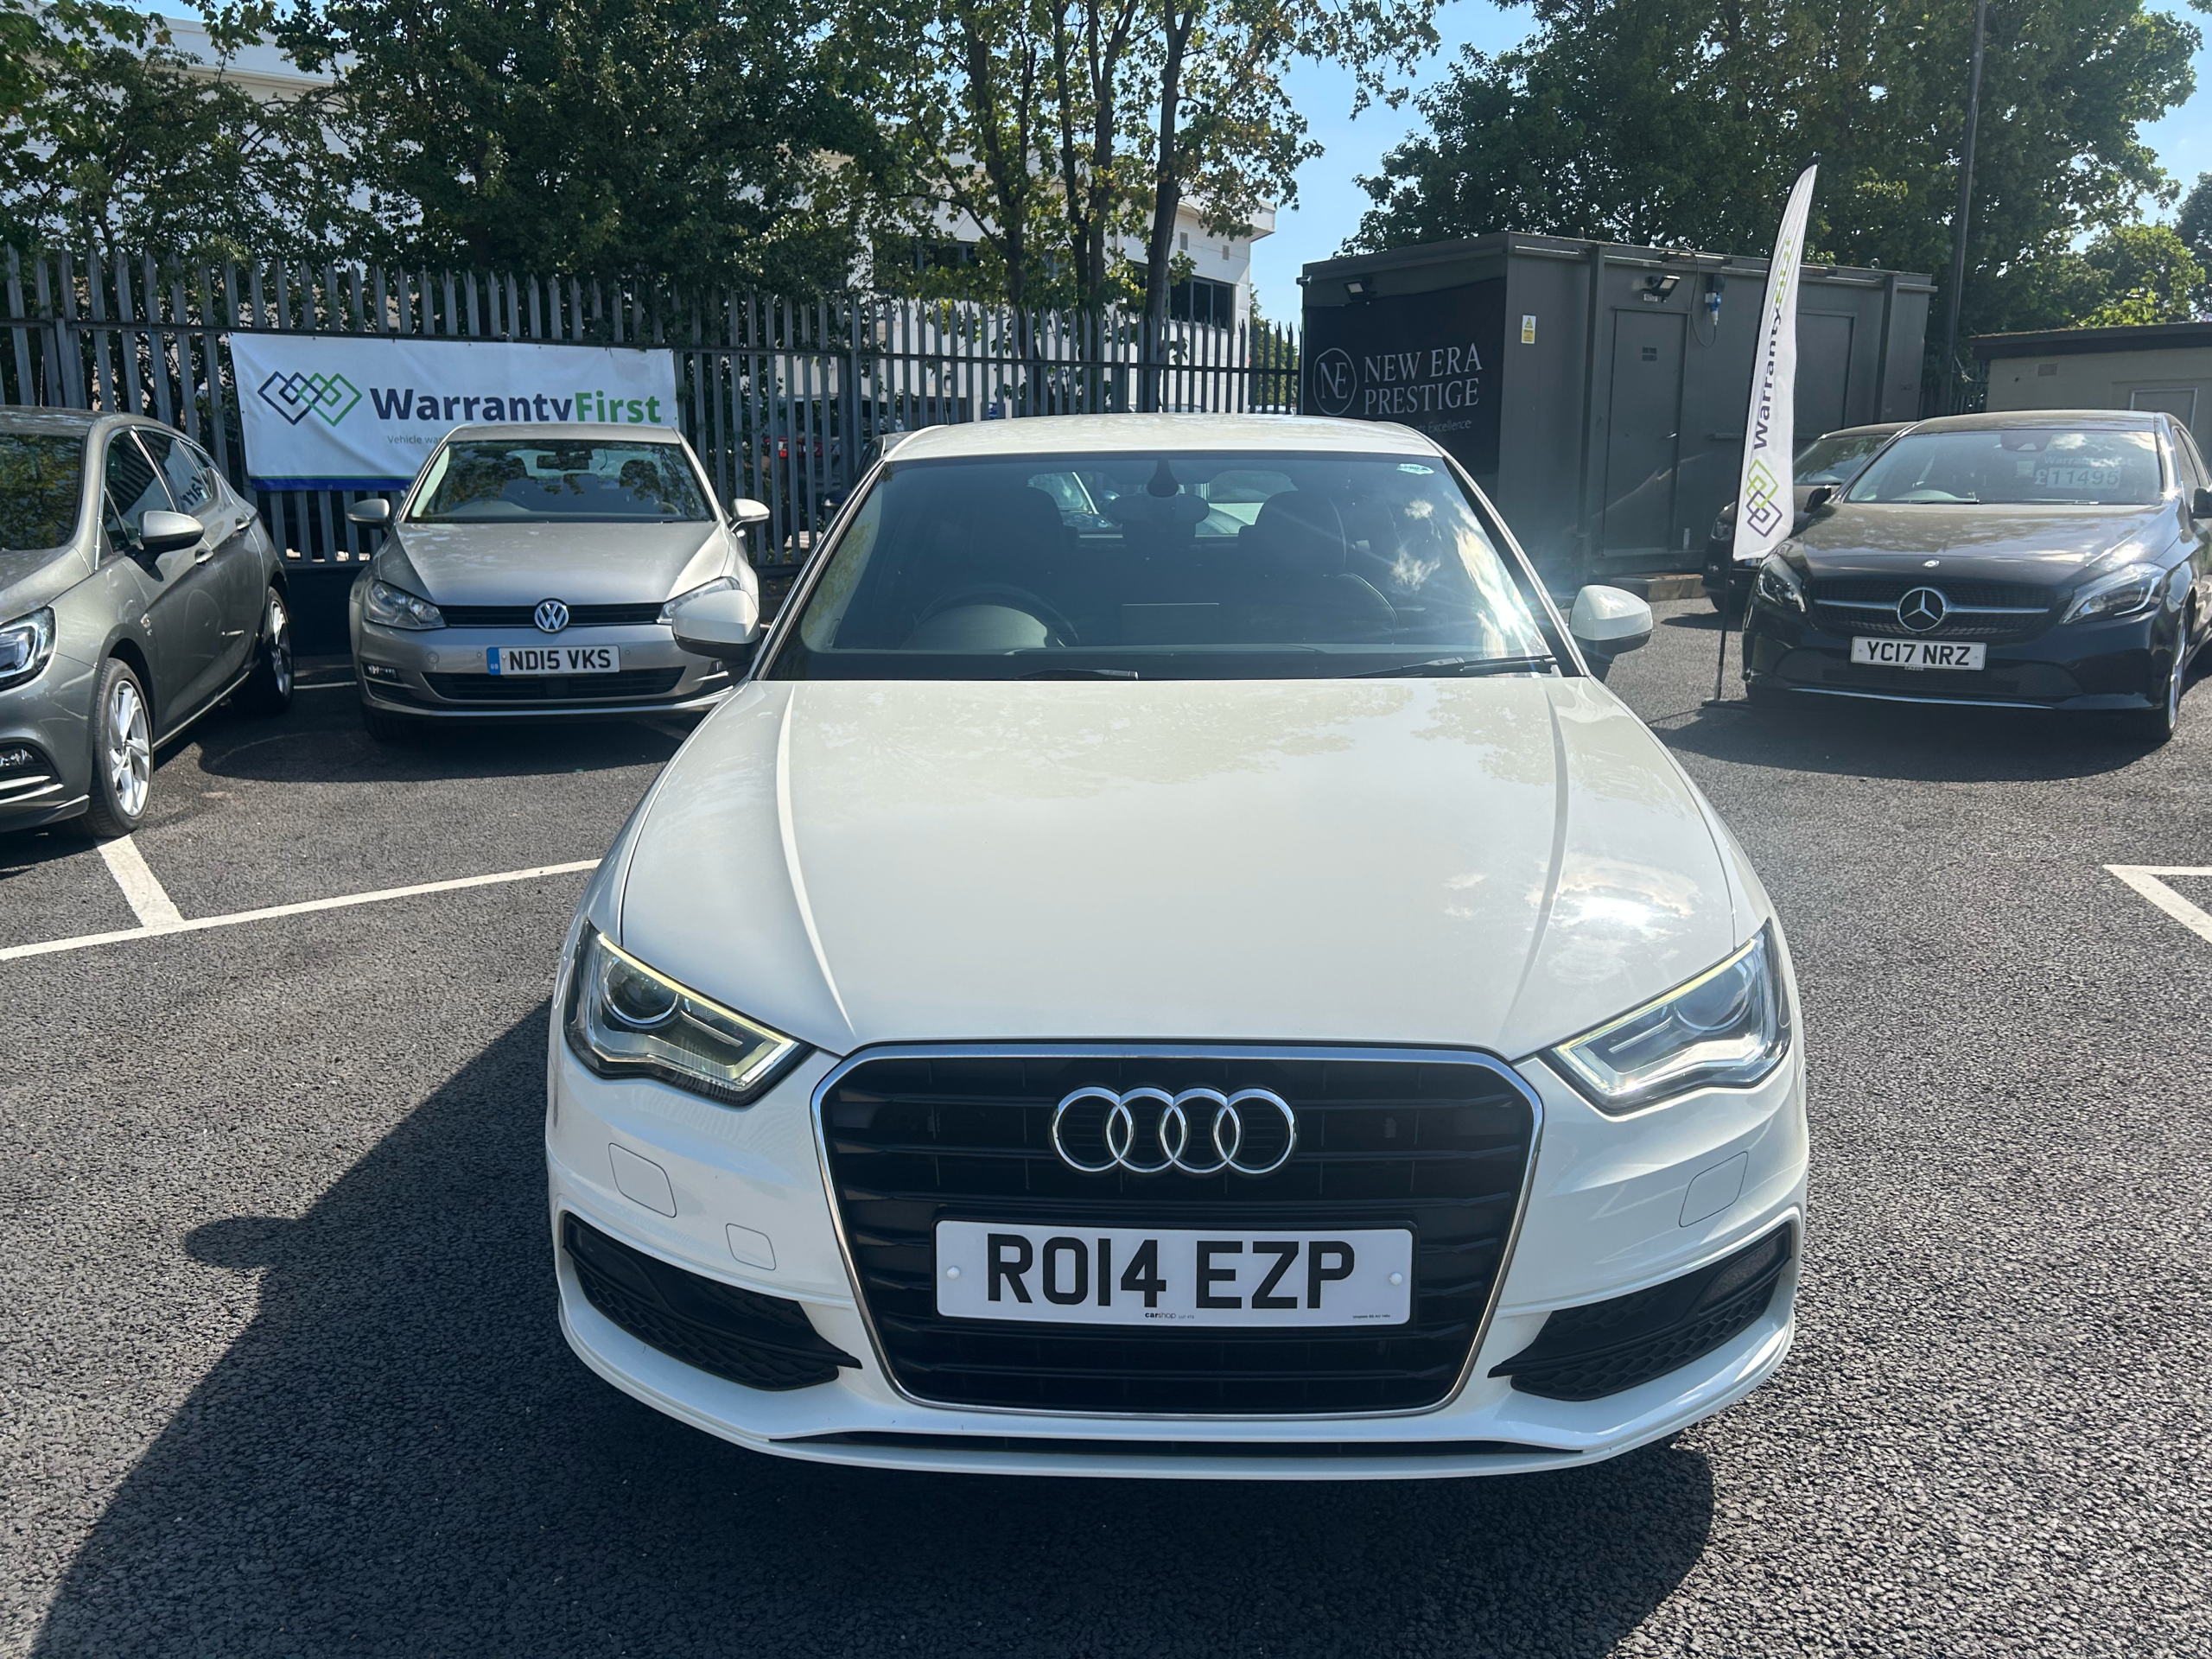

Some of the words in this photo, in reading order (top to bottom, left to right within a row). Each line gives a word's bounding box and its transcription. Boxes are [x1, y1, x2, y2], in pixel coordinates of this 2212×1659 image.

[1364, 352, 1422, 383] NEW
[1430, 343, 1483, 378] ERA
[369, 388, 662, 423] WarrantyFirst
[1363, 378, 1479, 415] PRESTIGE
[1427, 419, 1471, 434] Excellence
[387, 435, 423, 444] Vehicle
[2034, 468, 2120, 486] £11495
[509, 650, 561, 671] ND15
[567, 649, 611, 669] VKS
[1867, 641, 1916, 662] YC17
[1923, 645, 1971, 666] NRZ
[987, 1232, 1167, 1309] RO14
[1196, 1240, 1356, 1310] EZP
